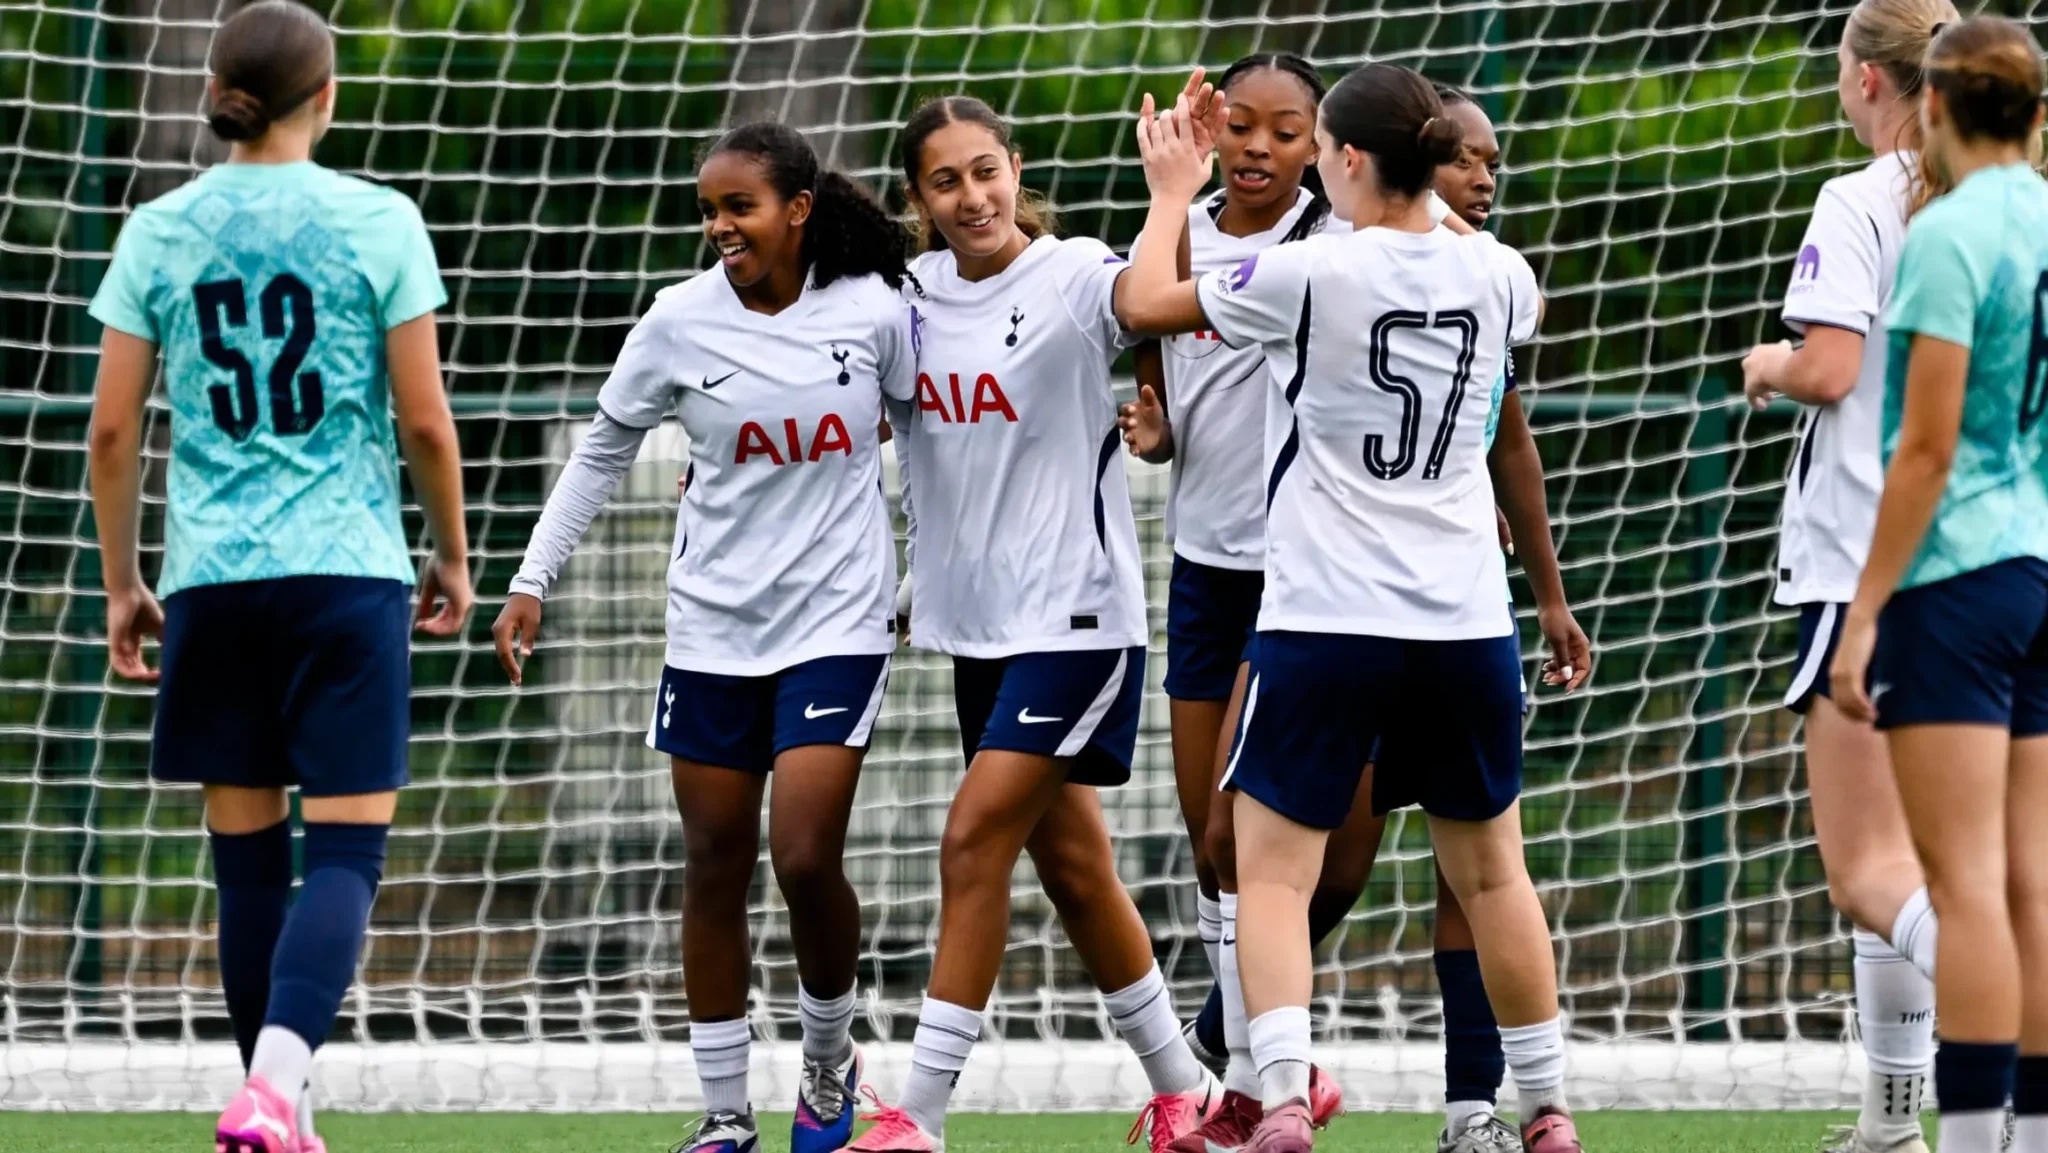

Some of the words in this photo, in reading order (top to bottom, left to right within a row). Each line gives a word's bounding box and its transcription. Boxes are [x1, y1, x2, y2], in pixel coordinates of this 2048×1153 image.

[192, 272, 325, 442] 52
[916, 372, 1019, 424] AIA
[1363, 310, 1480, 480] 57
[734, 413, 852, 465] AIA
